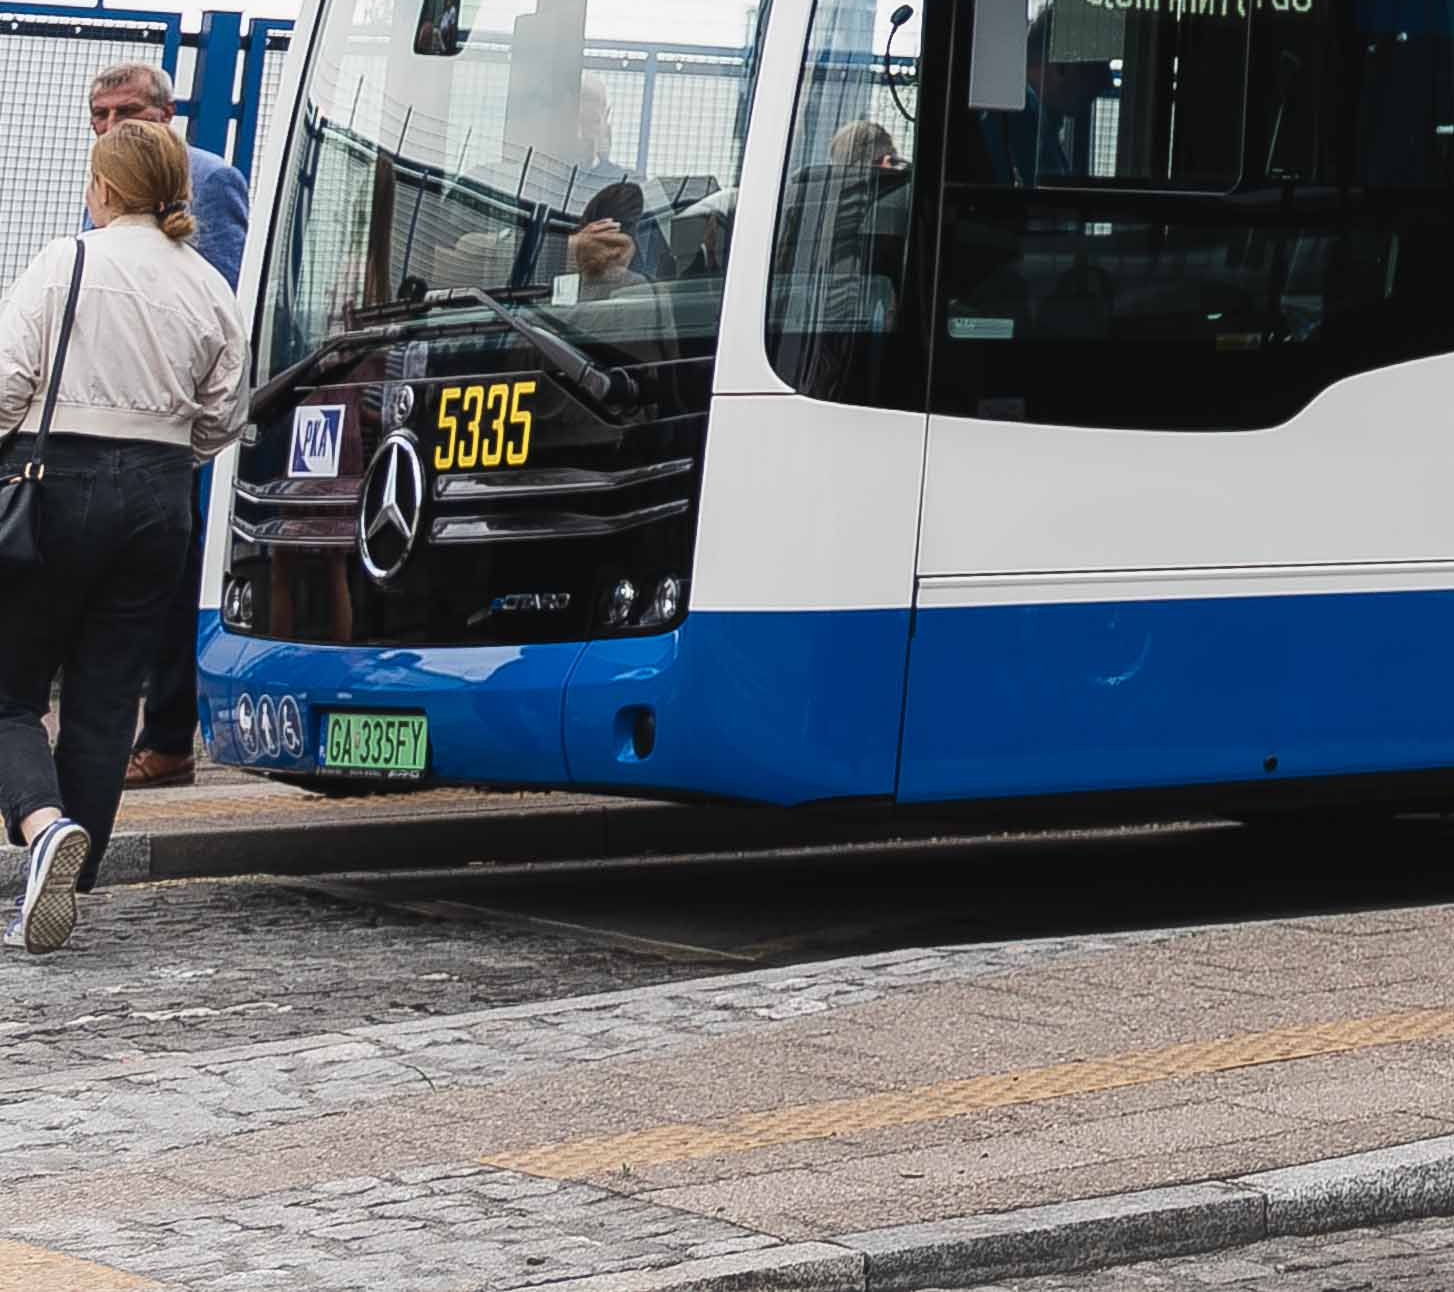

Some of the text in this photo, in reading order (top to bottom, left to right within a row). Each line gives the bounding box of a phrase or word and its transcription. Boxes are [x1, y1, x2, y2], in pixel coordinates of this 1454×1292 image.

[303, 419, 330, 457] PKA
[434, 381, 537, 470] 5335
[330, 719, 424, 766] GA 335FY
